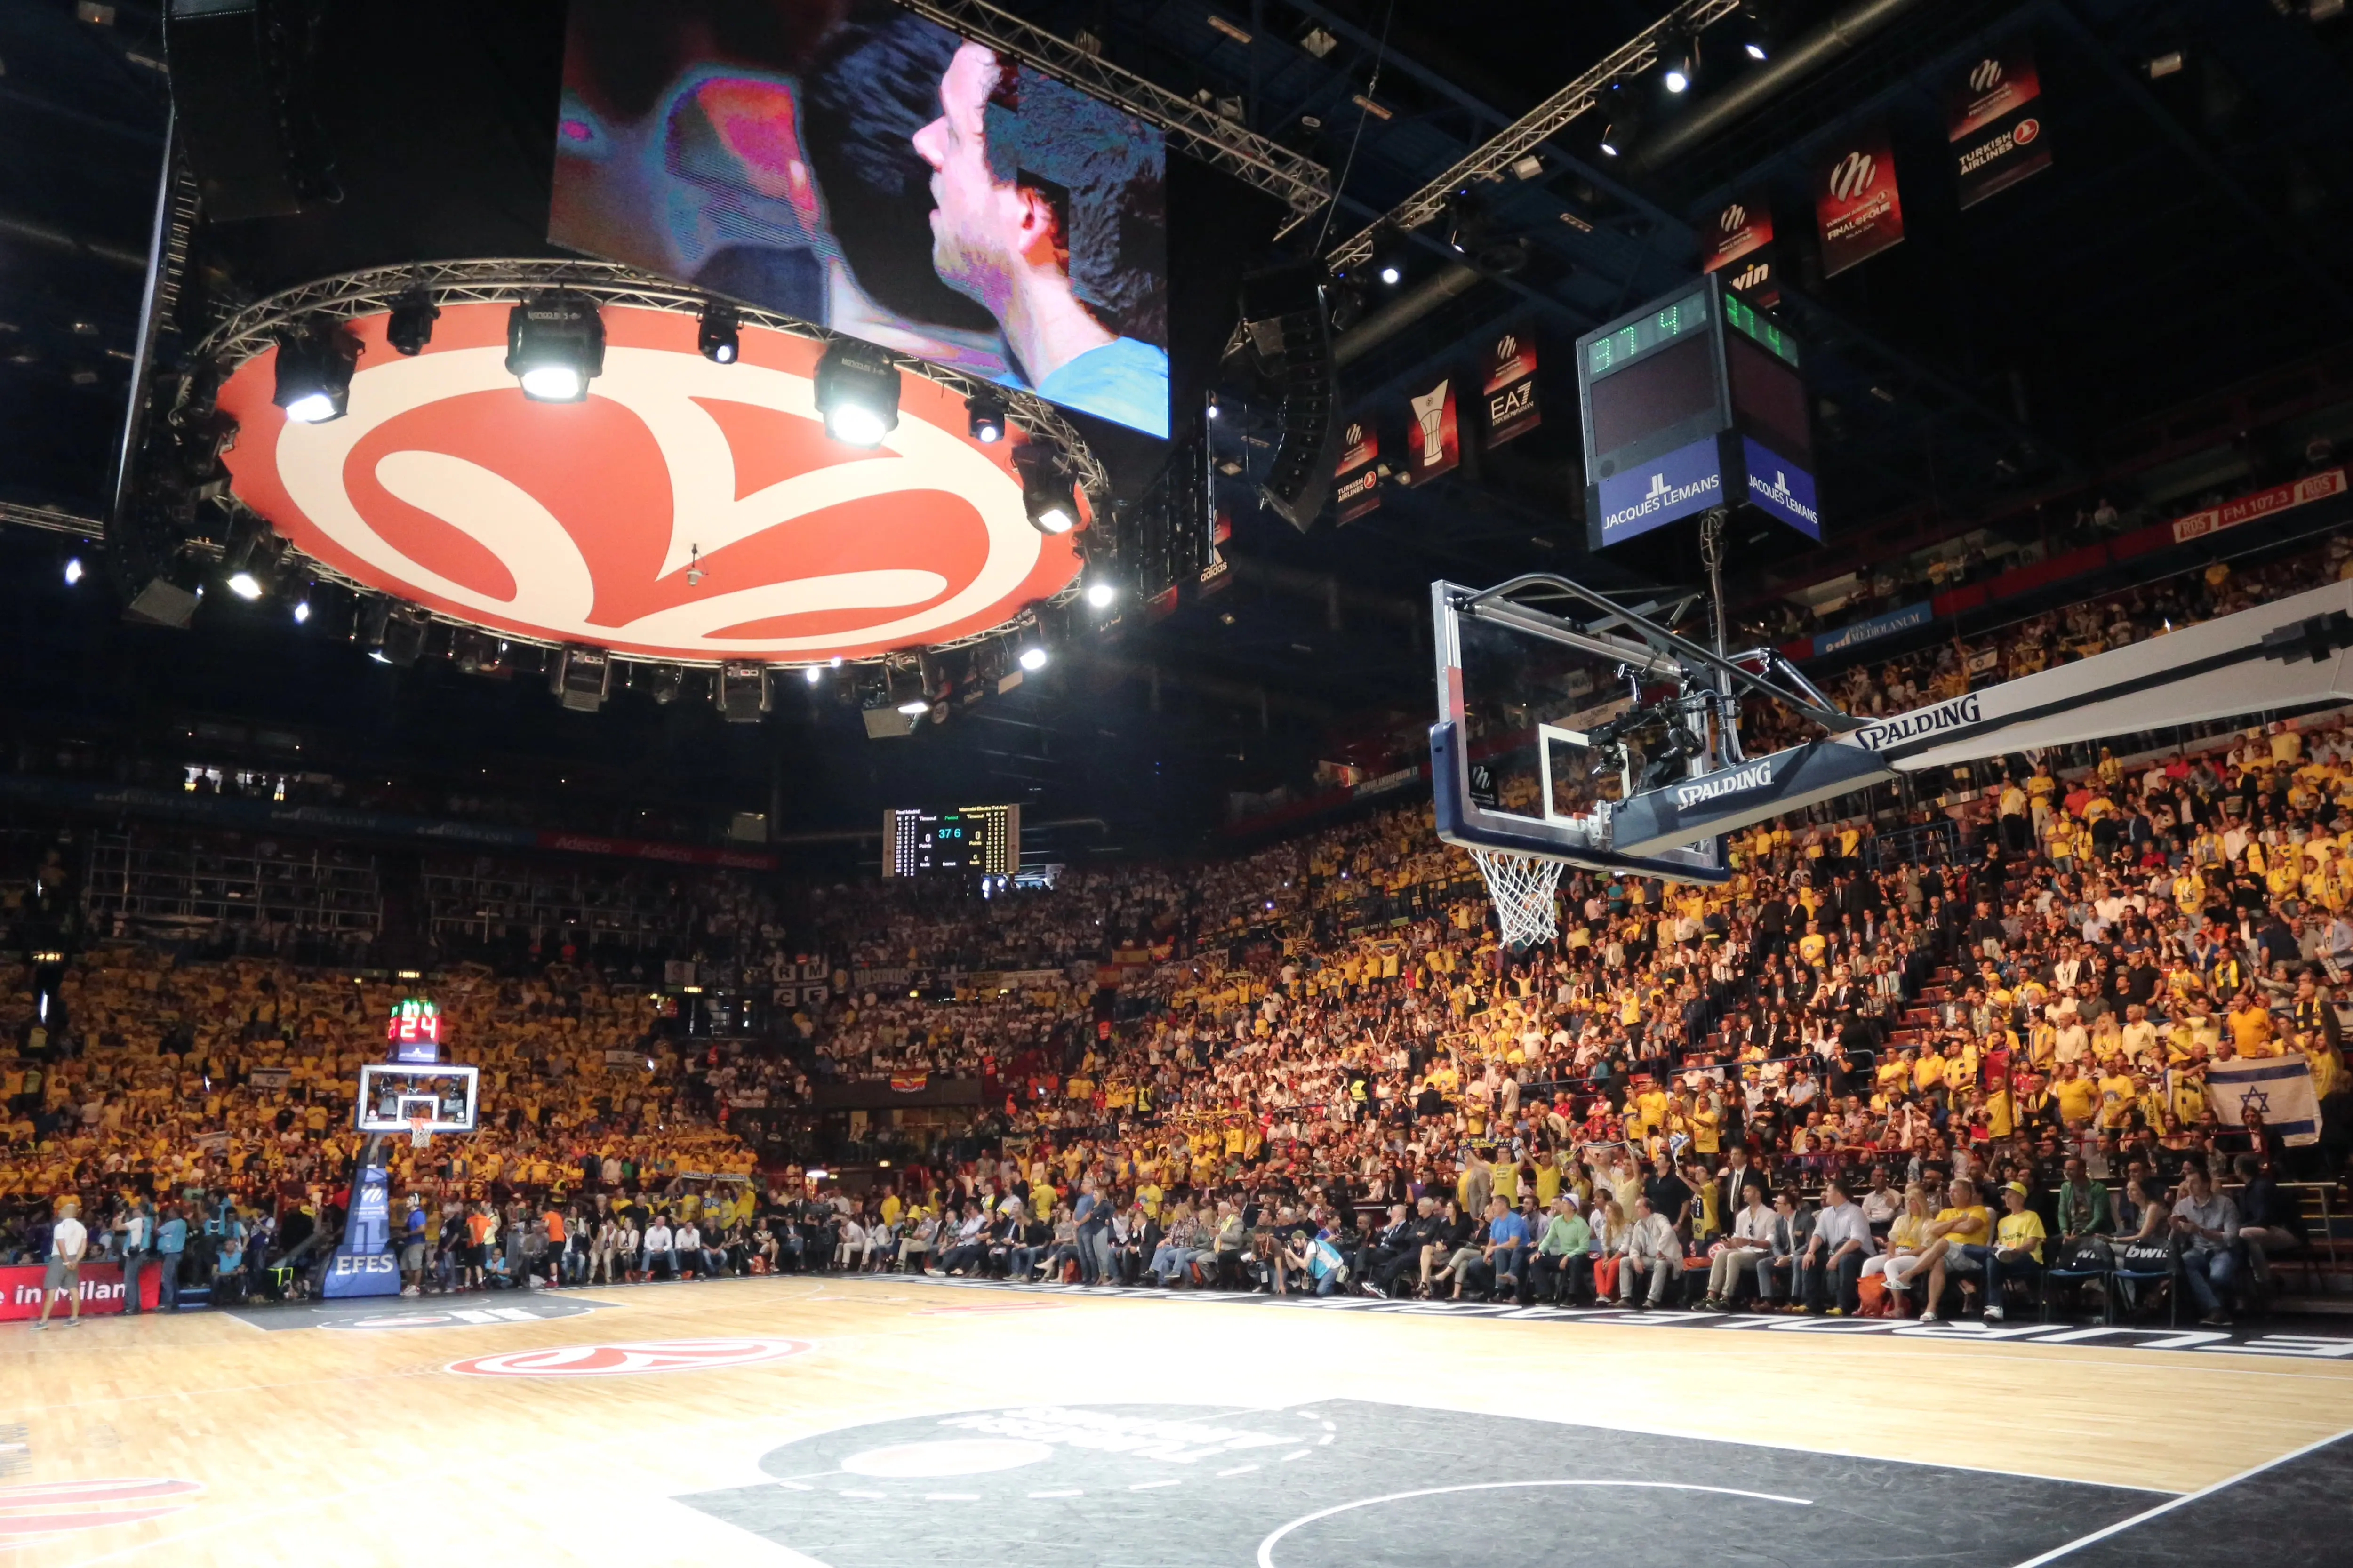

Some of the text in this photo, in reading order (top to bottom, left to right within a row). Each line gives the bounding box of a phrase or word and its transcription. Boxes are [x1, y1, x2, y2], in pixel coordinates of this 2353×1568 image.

[1959, 130, 2012, 165] TURKISH
[1961, 140, 2014, 176] AIRLINES
[1827, 201, 1891, 240] FINAL FOUR
[1491, 380, 1532, 420] EA7
[1337, 477, 1364, 496] TURKISH
[1337, 485, 1364, 503] AIRLINES
[1604, 474, 1720, 530] JACQUES LEMANS
[1749, 474, 1818, 525] JACQUES LEMANS
[2223, 504, 2246, 521] FM
[2250, 491, 2288, 512] 107.3
[1200, 561, 1228, 582] adidas
[1850, 613, 1920, 642] MEDIOLANUM
[1855, 694, 1981, 752] SPALDING
[1677, 761, 1774, 812] SPALDING
[555, 837, 611, 853] Adecco
[925, 833, 931, 842] 0
[975, 831, 981, 840] 0
[640, 844, 692, 862] Adecco
[779, 964, 822, 978] R M
[779, 992, 790, 1002] C
[400, 1017, 437, 1038] 24
[336, 1254, 394, 1276] EFES
[15, 1285, 41, 1304] in
[1262, 1295, 2353, 1357] EUROLEAGUE
